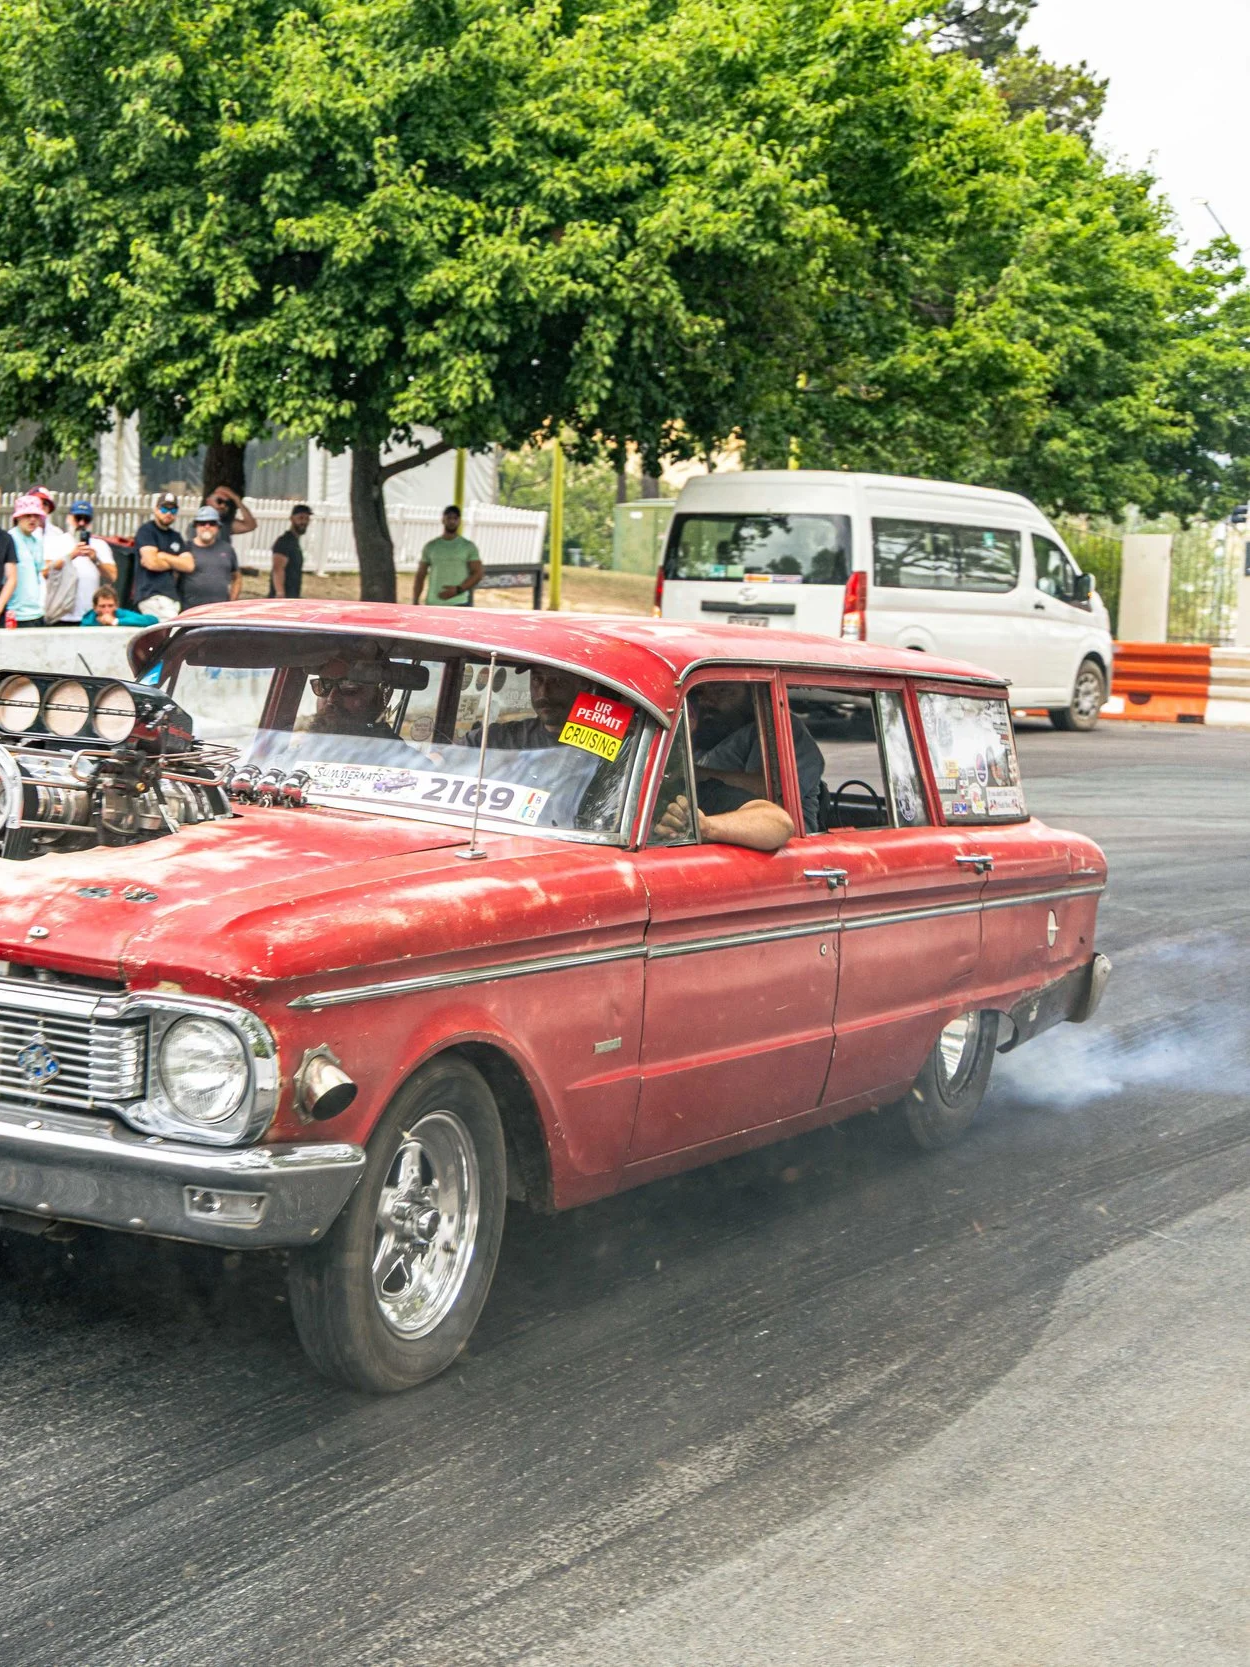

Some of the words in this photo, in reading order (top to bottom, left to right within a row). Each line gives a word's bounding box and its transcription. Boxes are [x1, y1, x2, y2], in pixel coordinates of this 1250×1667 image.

[594, 701, 613, 715] UR
[576, 707, 623, 731] PERMIT
[564, 725, 617, 757] CRUISING
[315, 766, 384, 782] SUMMERNATS
[336, 779, 350, 788] 38
[421, 778, 514, 811] 2169
